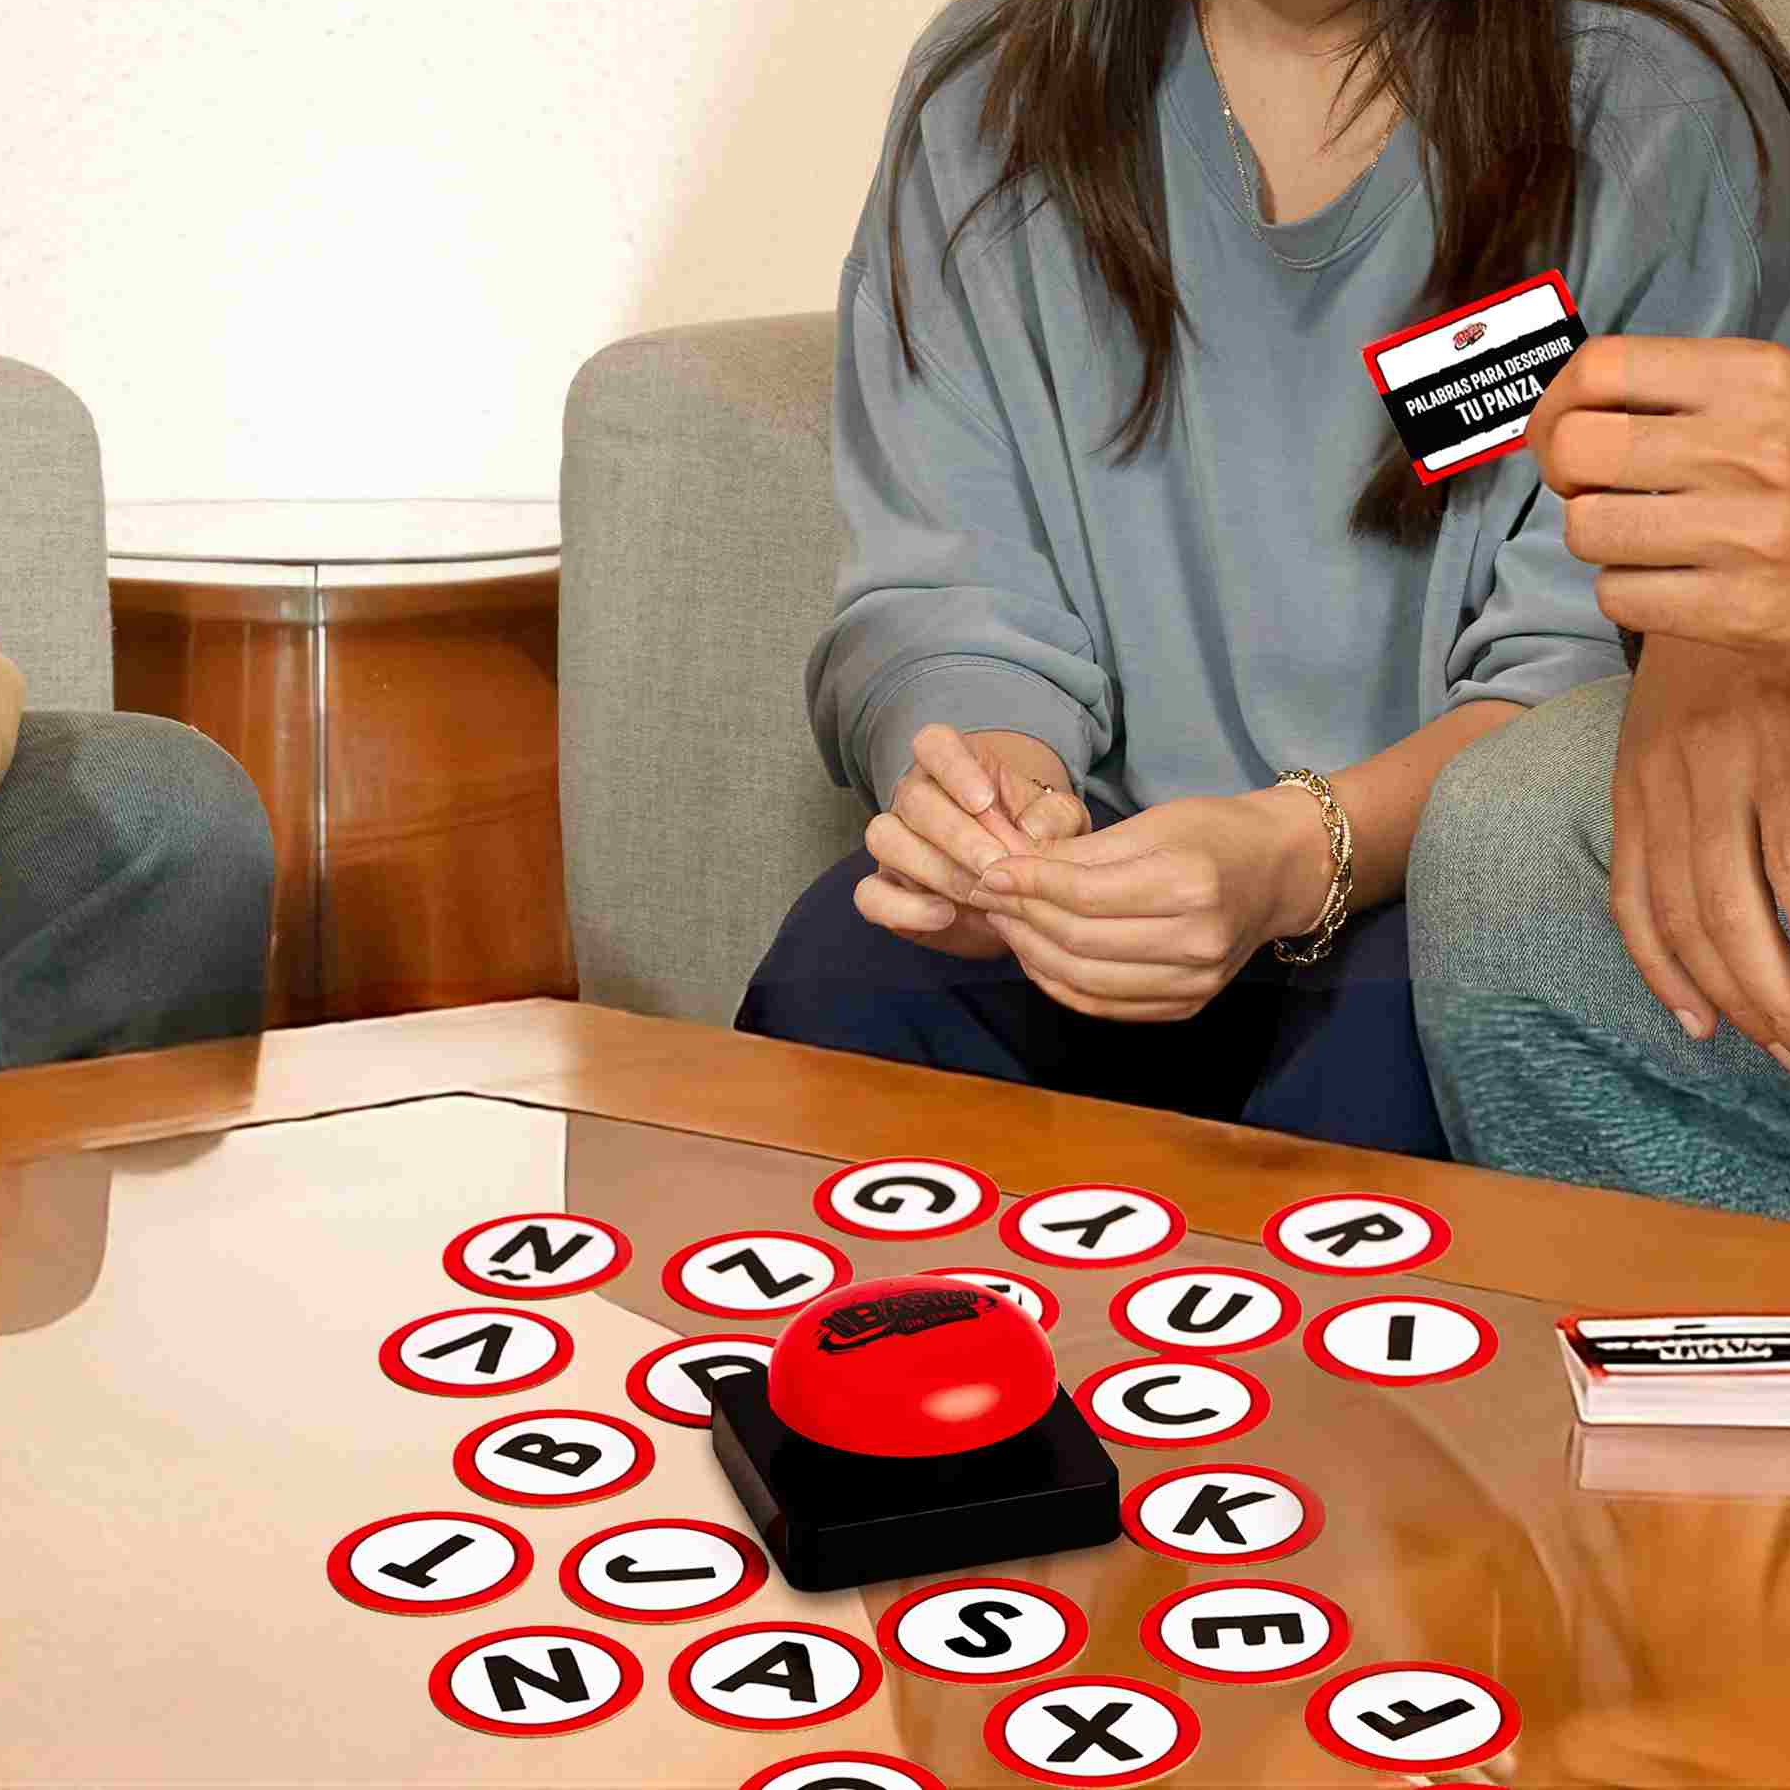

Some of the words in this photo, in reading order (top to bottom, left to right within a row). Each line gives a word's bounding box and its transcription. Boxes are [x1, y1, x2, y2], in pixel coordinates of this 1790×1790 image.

[1405, 377, 1472, 417] PALABRAS
[1472, 364, 1507, 391] PARA
[1504, 335, 1574, 376] DESCRIBIR
[1455, 395, 1484, 425] TU
[1484, 374, 1544, 416] PANZA
[853, 1176, 956, 1214] G
[1041, 1205, 1138, 1249] Y
[1305, 1213, 1404, 1257] R
[487, 1225, 594, 1281] Ñ
[1167, 1284, 1253, 1333] U
[1387, 1315, 1416, 1361] I
[1122, 1375, 1219, 1425] C
[493, 1432, 602, 1477] B
[1172, 1484, 1275, 1545] K
[377, 1534, 475, 1588] T
[605, 1554, 716, 1583] J
[944, 1600, 1023, 1658] S
[1191, 1612, 1305, 1649] E
[483, 1647, 590, 1712] N
[711, 1640, 818, 1703] A
[1042, 1702, 1144, 1763] X
[1356, 1698, 1475, 1742] F
